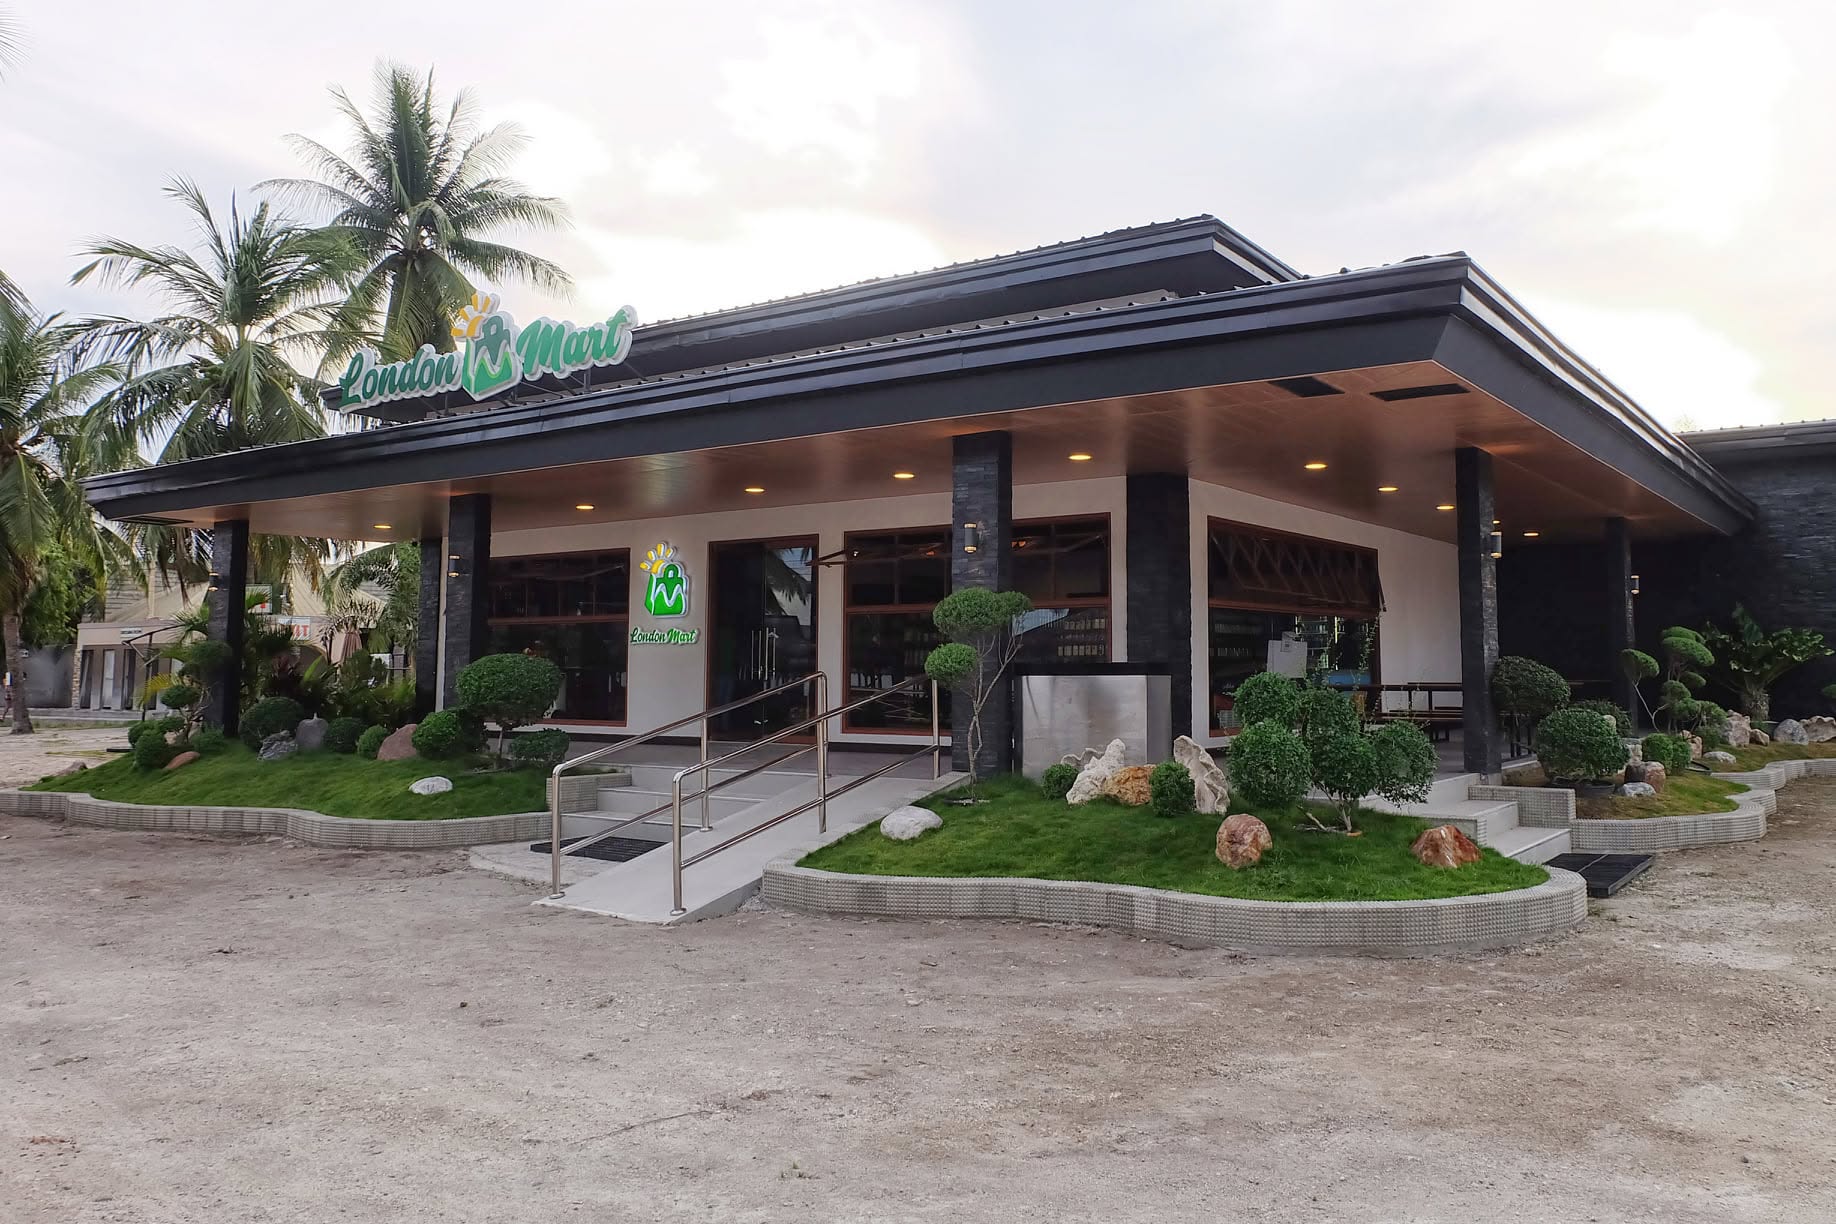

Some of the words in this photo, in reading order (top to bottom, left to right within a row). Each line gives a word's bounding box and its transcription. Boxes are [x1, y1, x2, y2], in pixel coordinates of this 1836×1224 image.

[340, 350, 456, 408] London
[516, 308, 629, 375] Mart
[630, 627, 666, 643] London
[667, 628, 698, 643] Mart
